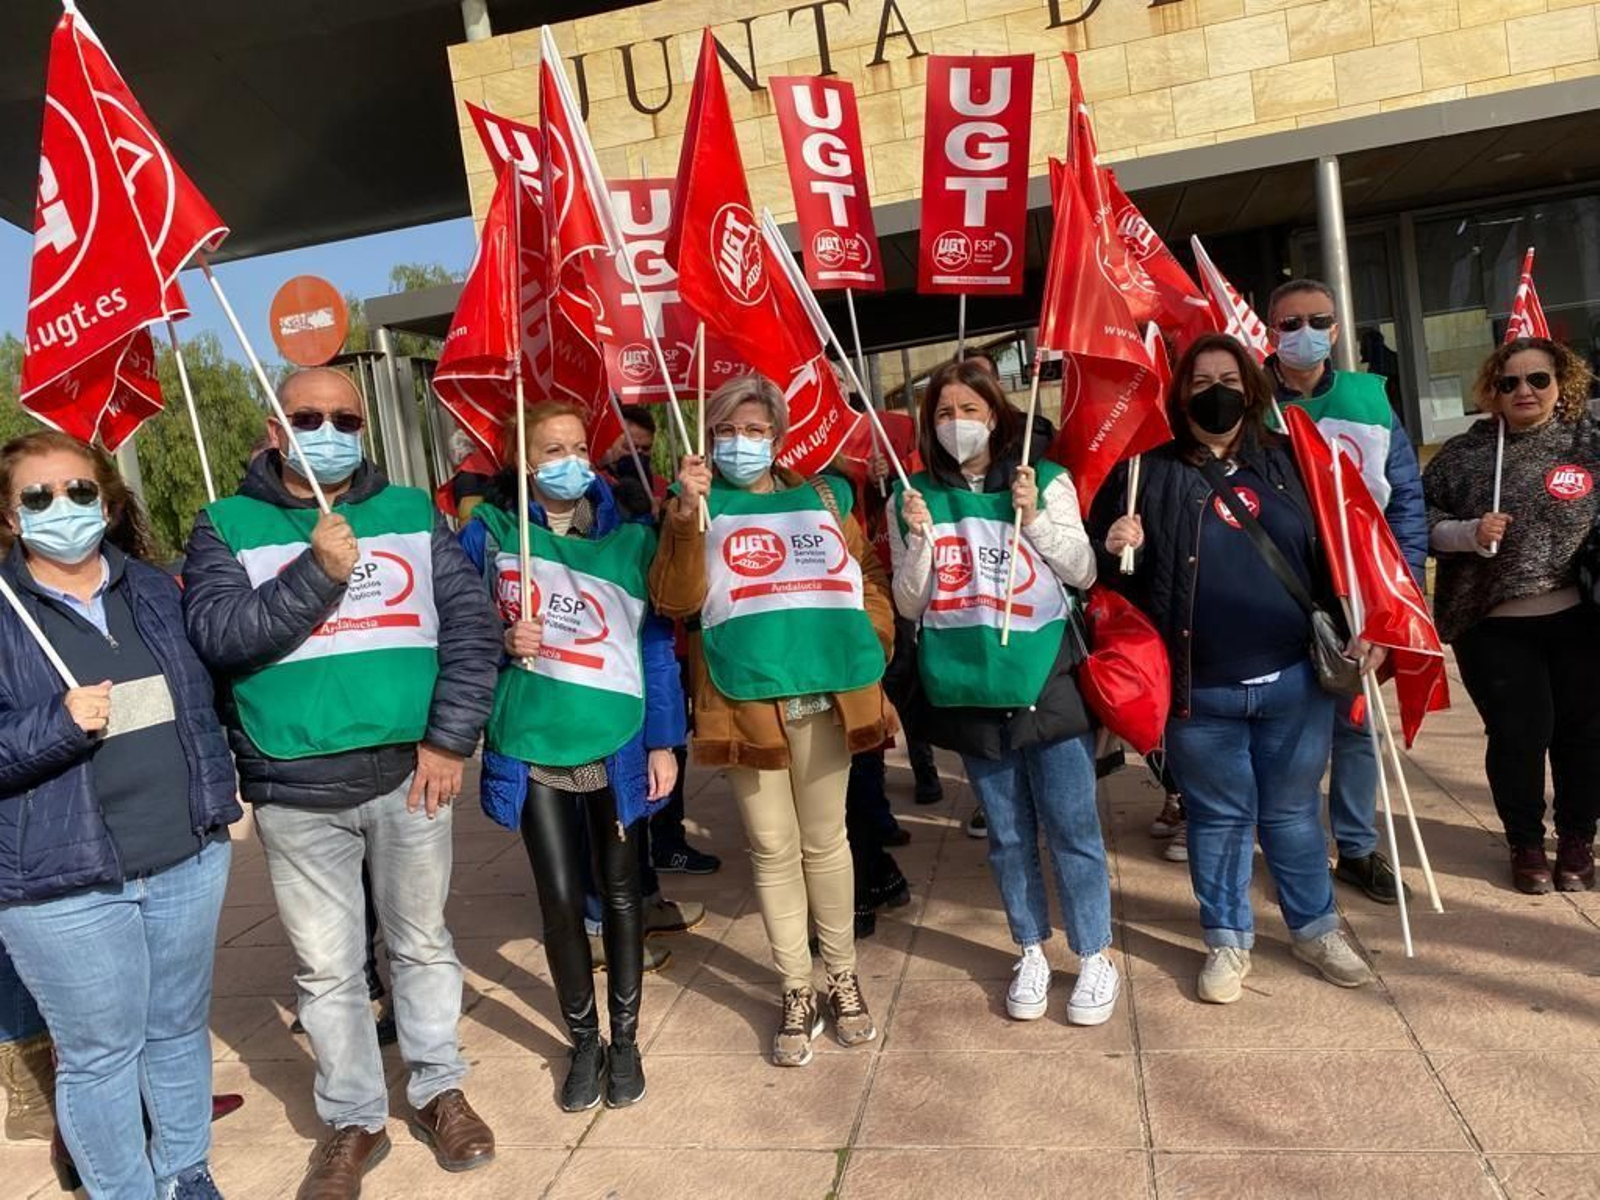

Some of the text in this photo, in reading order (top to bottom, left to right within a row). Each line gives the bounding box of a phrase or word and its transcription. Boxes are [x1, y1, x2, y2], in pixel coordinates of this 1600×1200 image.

[567, 0, 929, 122] JUNTA
[791, 85, 857, 228] UGT
[944, 67, 1012, 227] UGT
[718, 213, 753, 284] UGT
[817, 237, 840, 252] UGT
[939, 238, 966, 254] UGT
[974, 240, 996, 252] FSP
[610, 189, 681, 340] UGT
[623, 351, 650, 366] UGT
[664, 349, 680, 361] SP
[1551, 471, 1585, 487] UGT
[730, 534, 776, 557] UGT
[933, 543, 971, 566] UGT
[350, 562, 378, 582] SP
[348, 580, 382, 593] ervicios
[548, 593, 586, 615] FeSP
